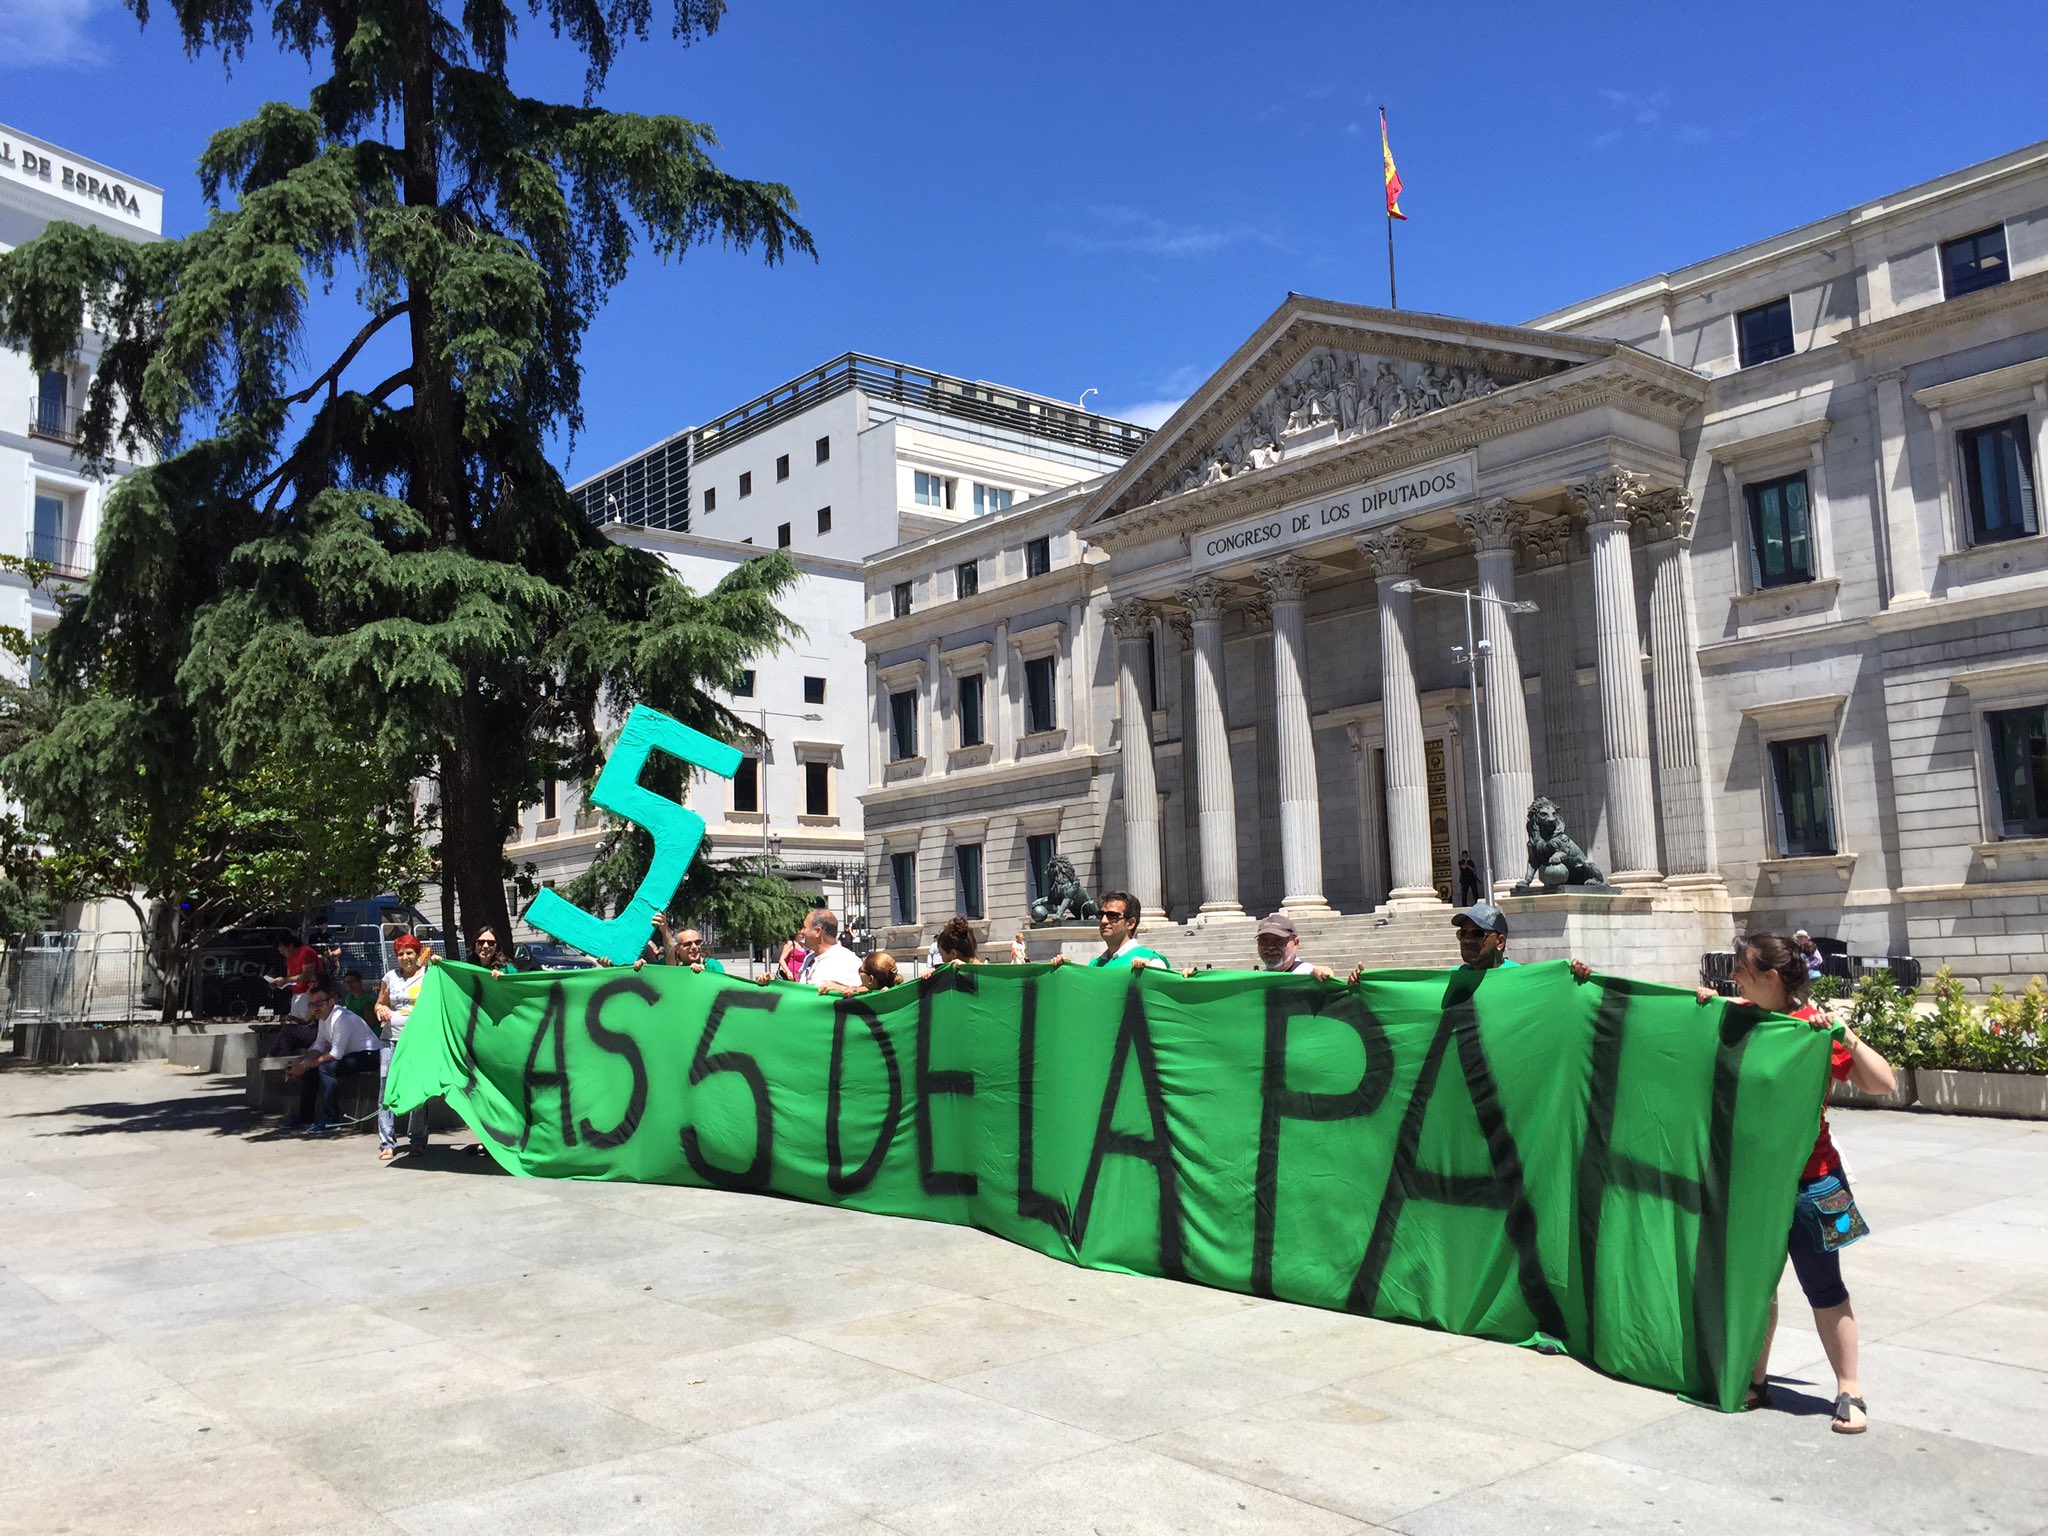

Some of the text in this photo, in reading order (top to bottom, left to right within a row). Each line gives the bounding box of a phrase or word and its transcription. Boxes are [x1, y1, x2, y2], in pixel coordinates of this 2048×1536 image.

[0, 142, 139, 212] L DE ESPAÑA
[1206, 472, 1456, 556] CONGRESO DE LOS DIPUTADOS
[464, 974, 661, 1152] LAS
[680, 990, 782, 1191] 5
